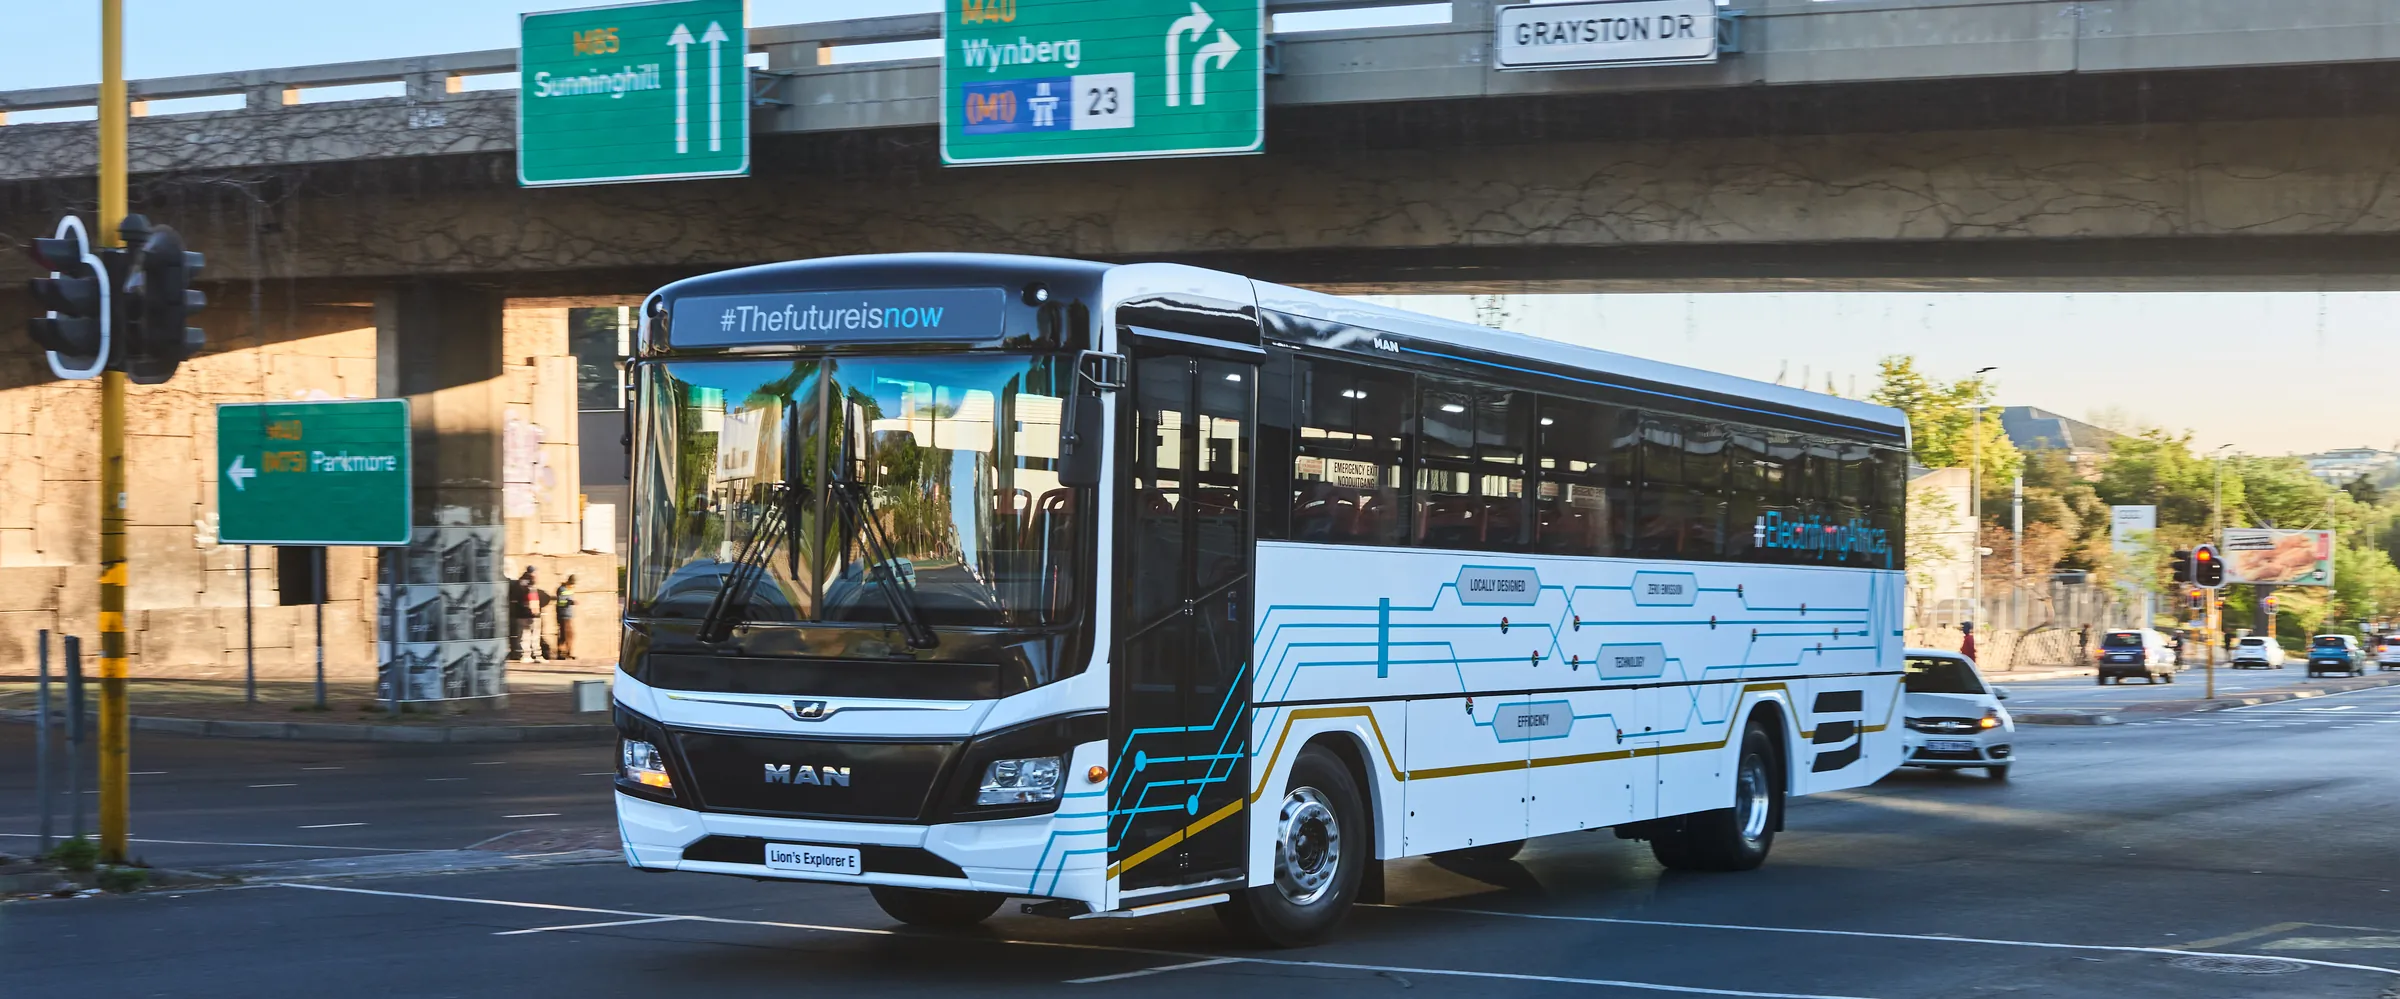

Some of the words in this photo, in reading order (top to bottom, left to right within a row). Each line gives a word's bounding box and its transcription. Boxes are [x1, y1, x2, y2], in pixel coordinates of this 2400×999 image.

[573, 27, 619, 56] M85
[1516, 17, 1649, 45] GRAYSTON
[1659, 14, 1694, 39] DR
[962, 36, 1081, 73] Wynberg
[534, 63, 660, 99] Sunninghill
[1087, 87, 1118, 116] 23
[720, 302, 943, 333] #Thefutureisnow
[1373, 337, 1400, 353] MAN
[310, 450, 396, 473] Parkmore
[1334, 462, 1365, 476] EMERGENCY
[1366, 465, 1378, 477] EXIT
[1470, 579, 1496, 592] LOCALLY
[1497, 579, 1526, 593] DESIGNED
[1615, 656, 1645, 668] TECHNOLOGY
[1517, 714, 1549, 728] EFFICIENCY
[764, 762, 851, 788] MAN
[771, 850, 801, 864] Lion's
[804, 852, 846, 868] Explorer
[848, 855, 855, 868] E
